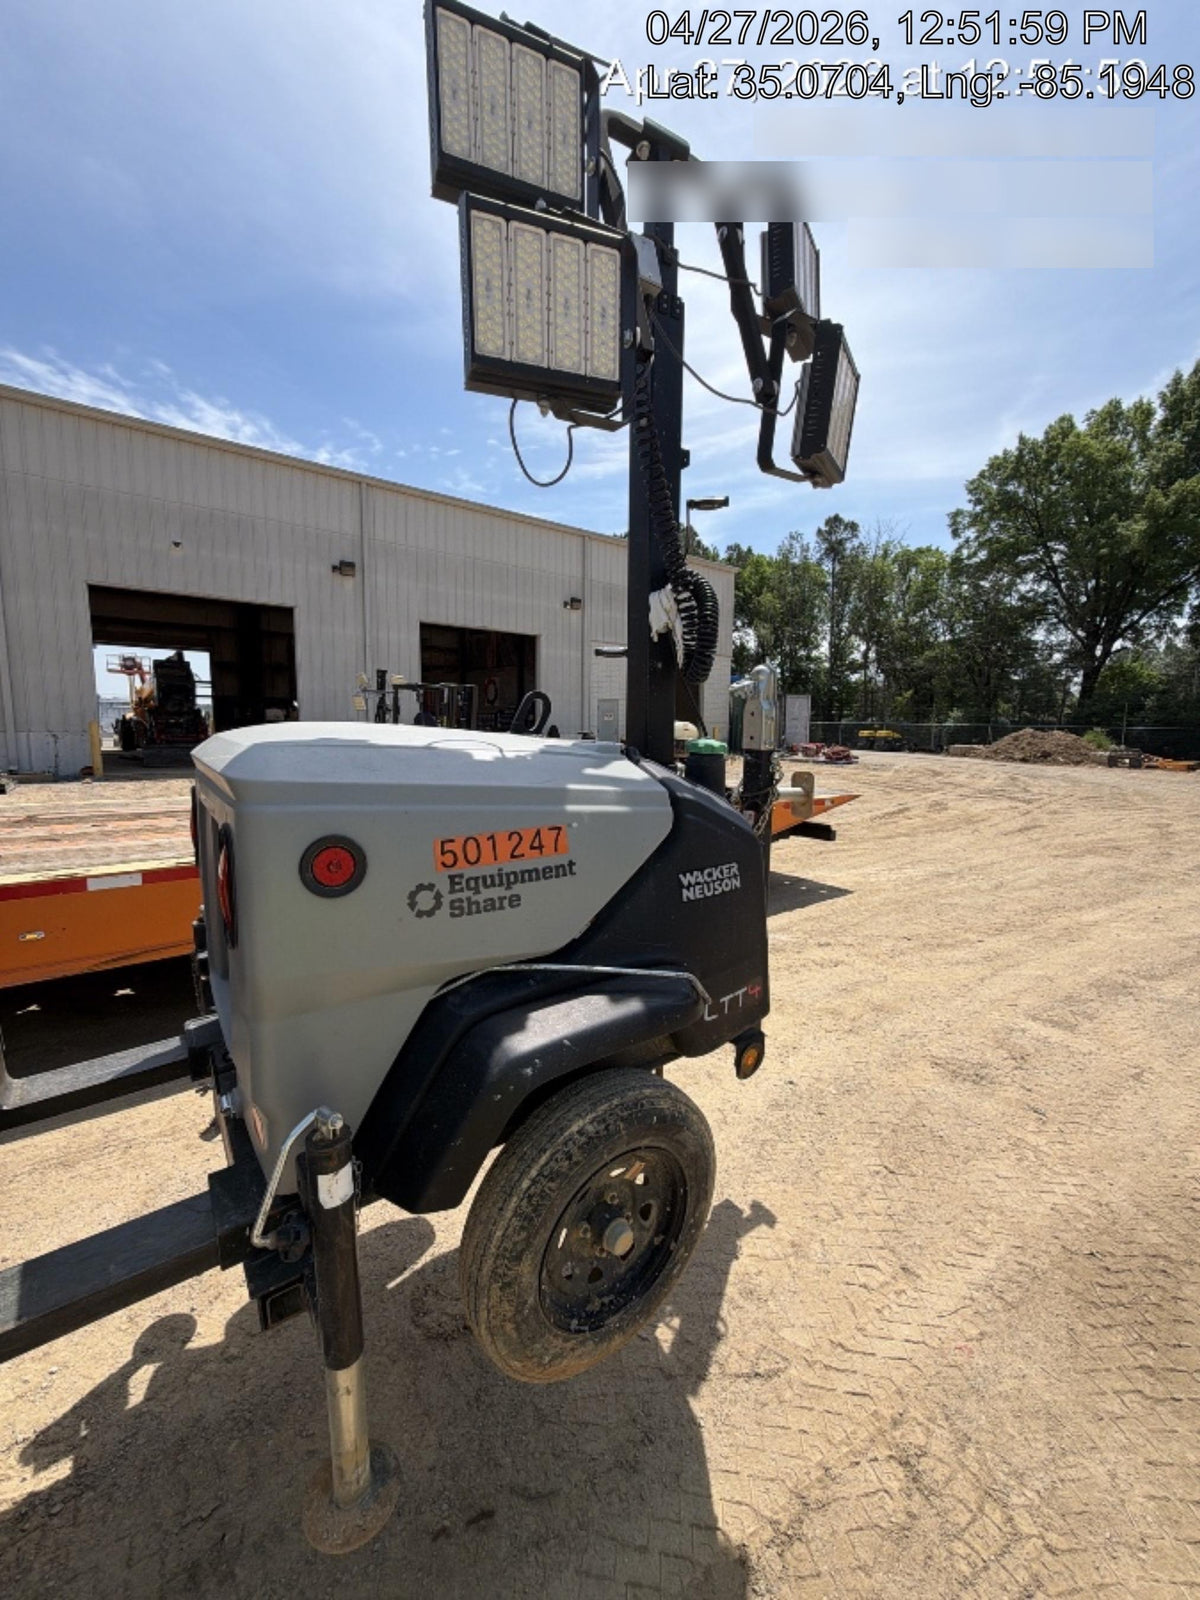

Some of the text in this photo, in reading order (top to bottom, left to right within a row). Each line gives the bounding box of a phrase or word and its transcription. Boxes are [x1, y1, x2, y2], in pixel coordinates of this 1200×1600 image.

[440, 826, 563, 869] 501247
[448, 859, 577, 895] Equipment
[679, 862, 740, 887] WACKER
[682, 876, 741, 902] NEUSON
[449, 893, 522, 919] Share
